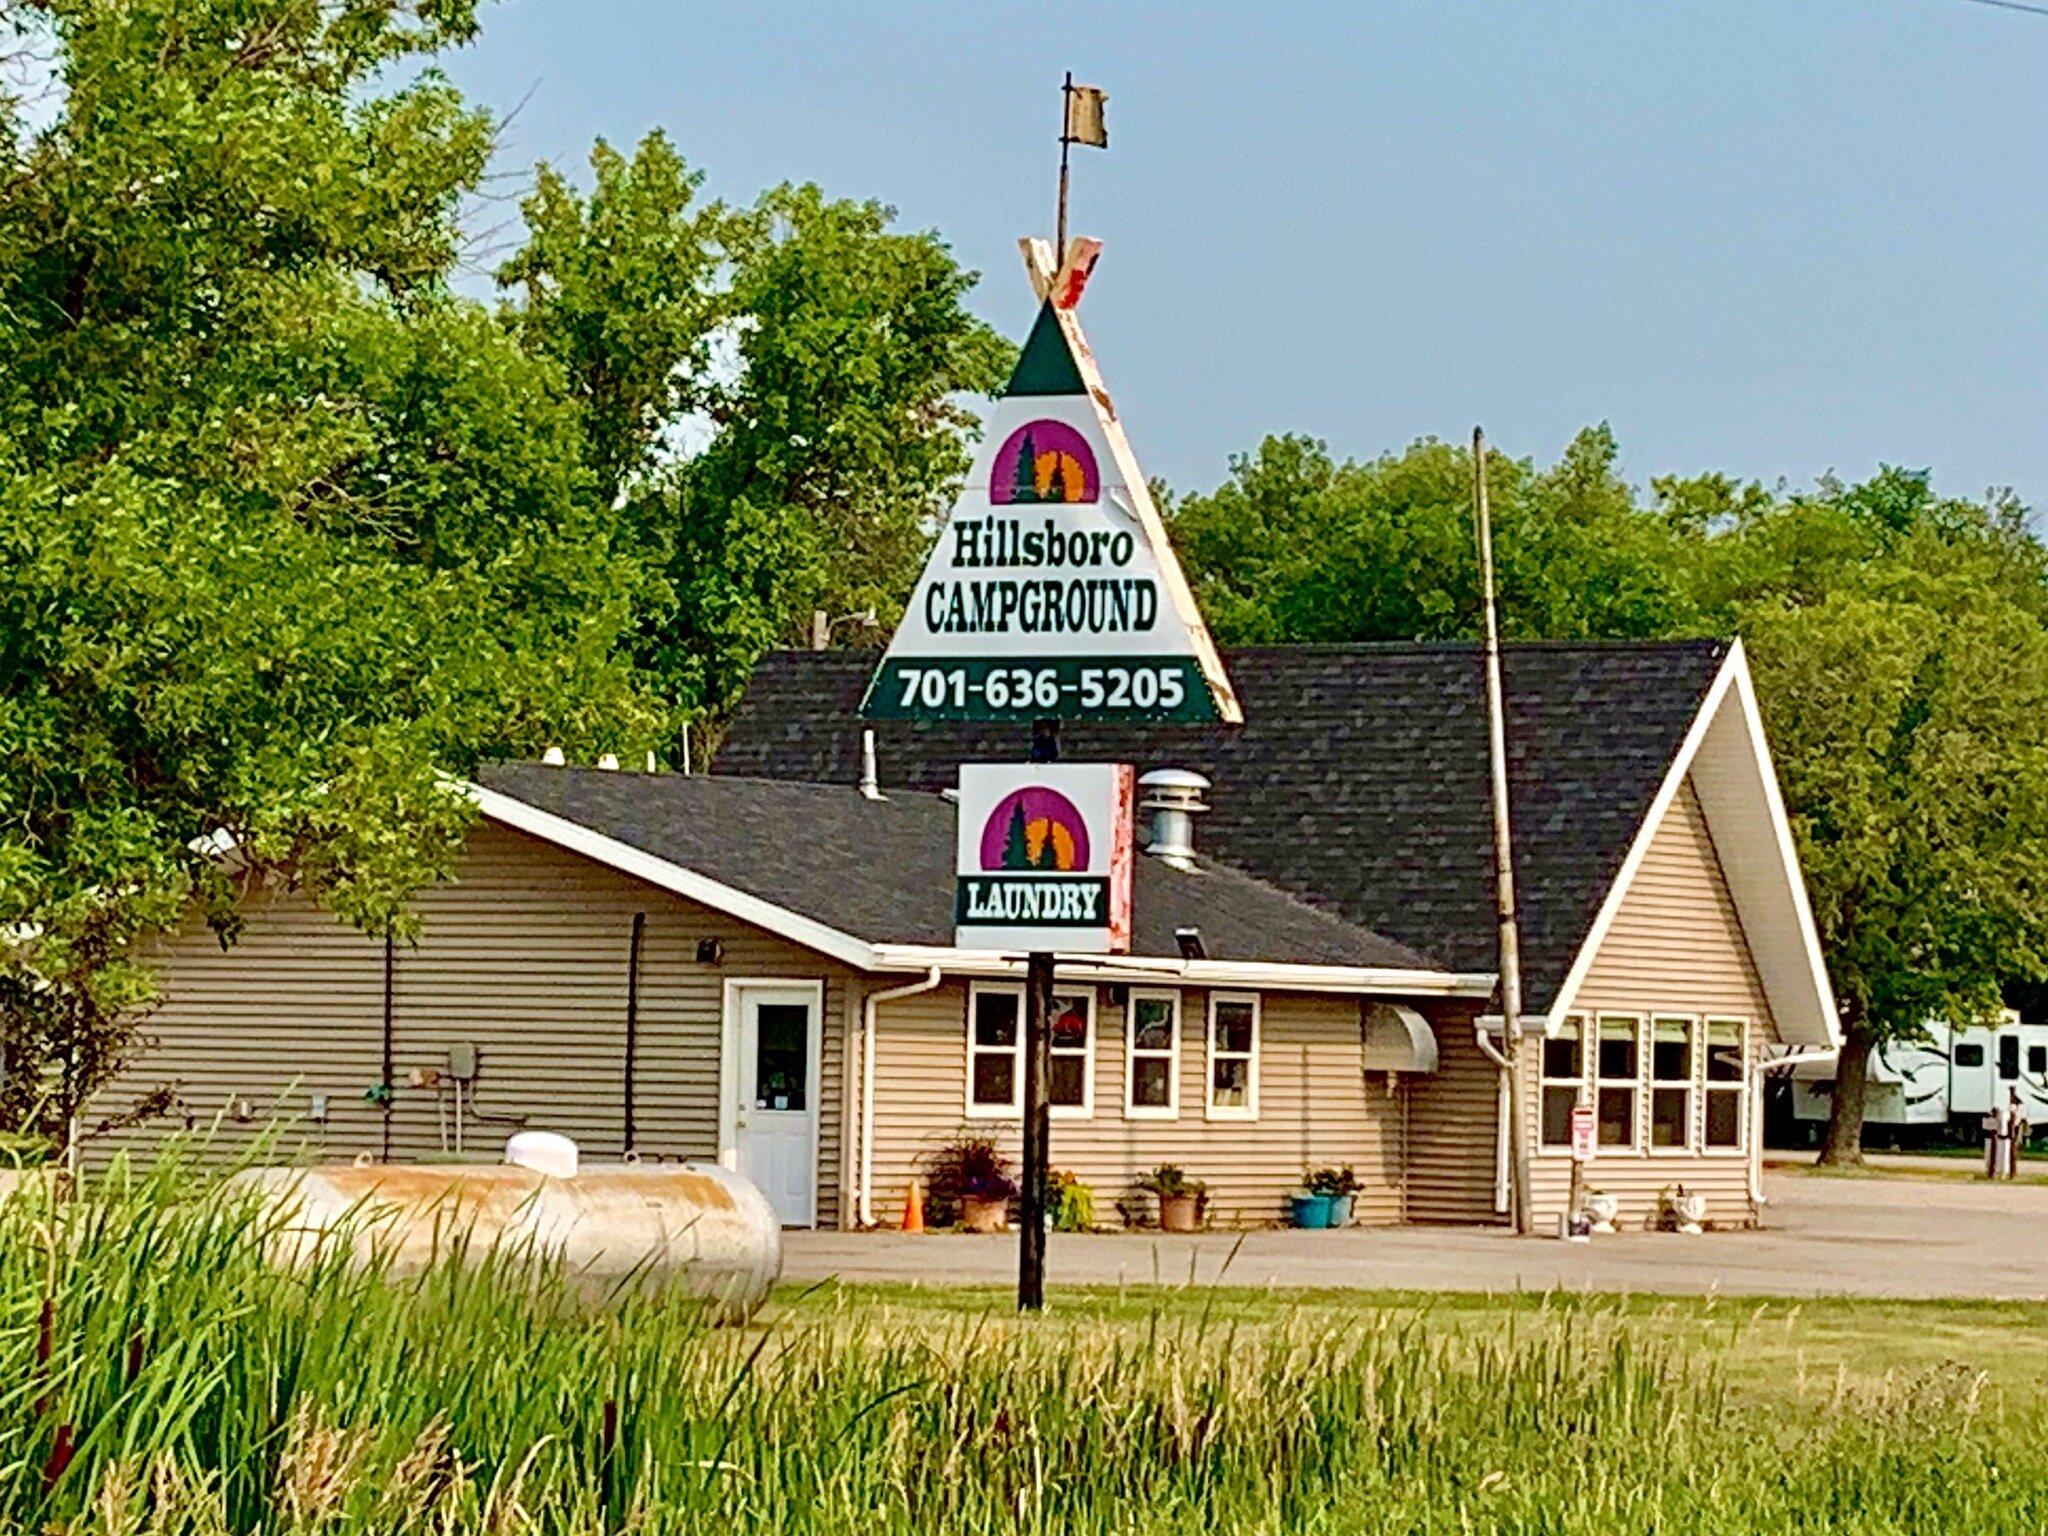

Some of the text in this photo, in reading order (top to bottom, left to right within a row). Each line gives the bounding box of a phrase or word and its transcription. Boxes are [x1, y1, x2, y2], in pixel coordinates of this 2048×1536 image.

[951, 515, 1133, 567] Hillsboro
[925, 579, 1158, 633] CAMPGROUND
[898, 668, 1184, 708] 701-636-5205
[966, 882, 1101, 920] LAUNDRY
